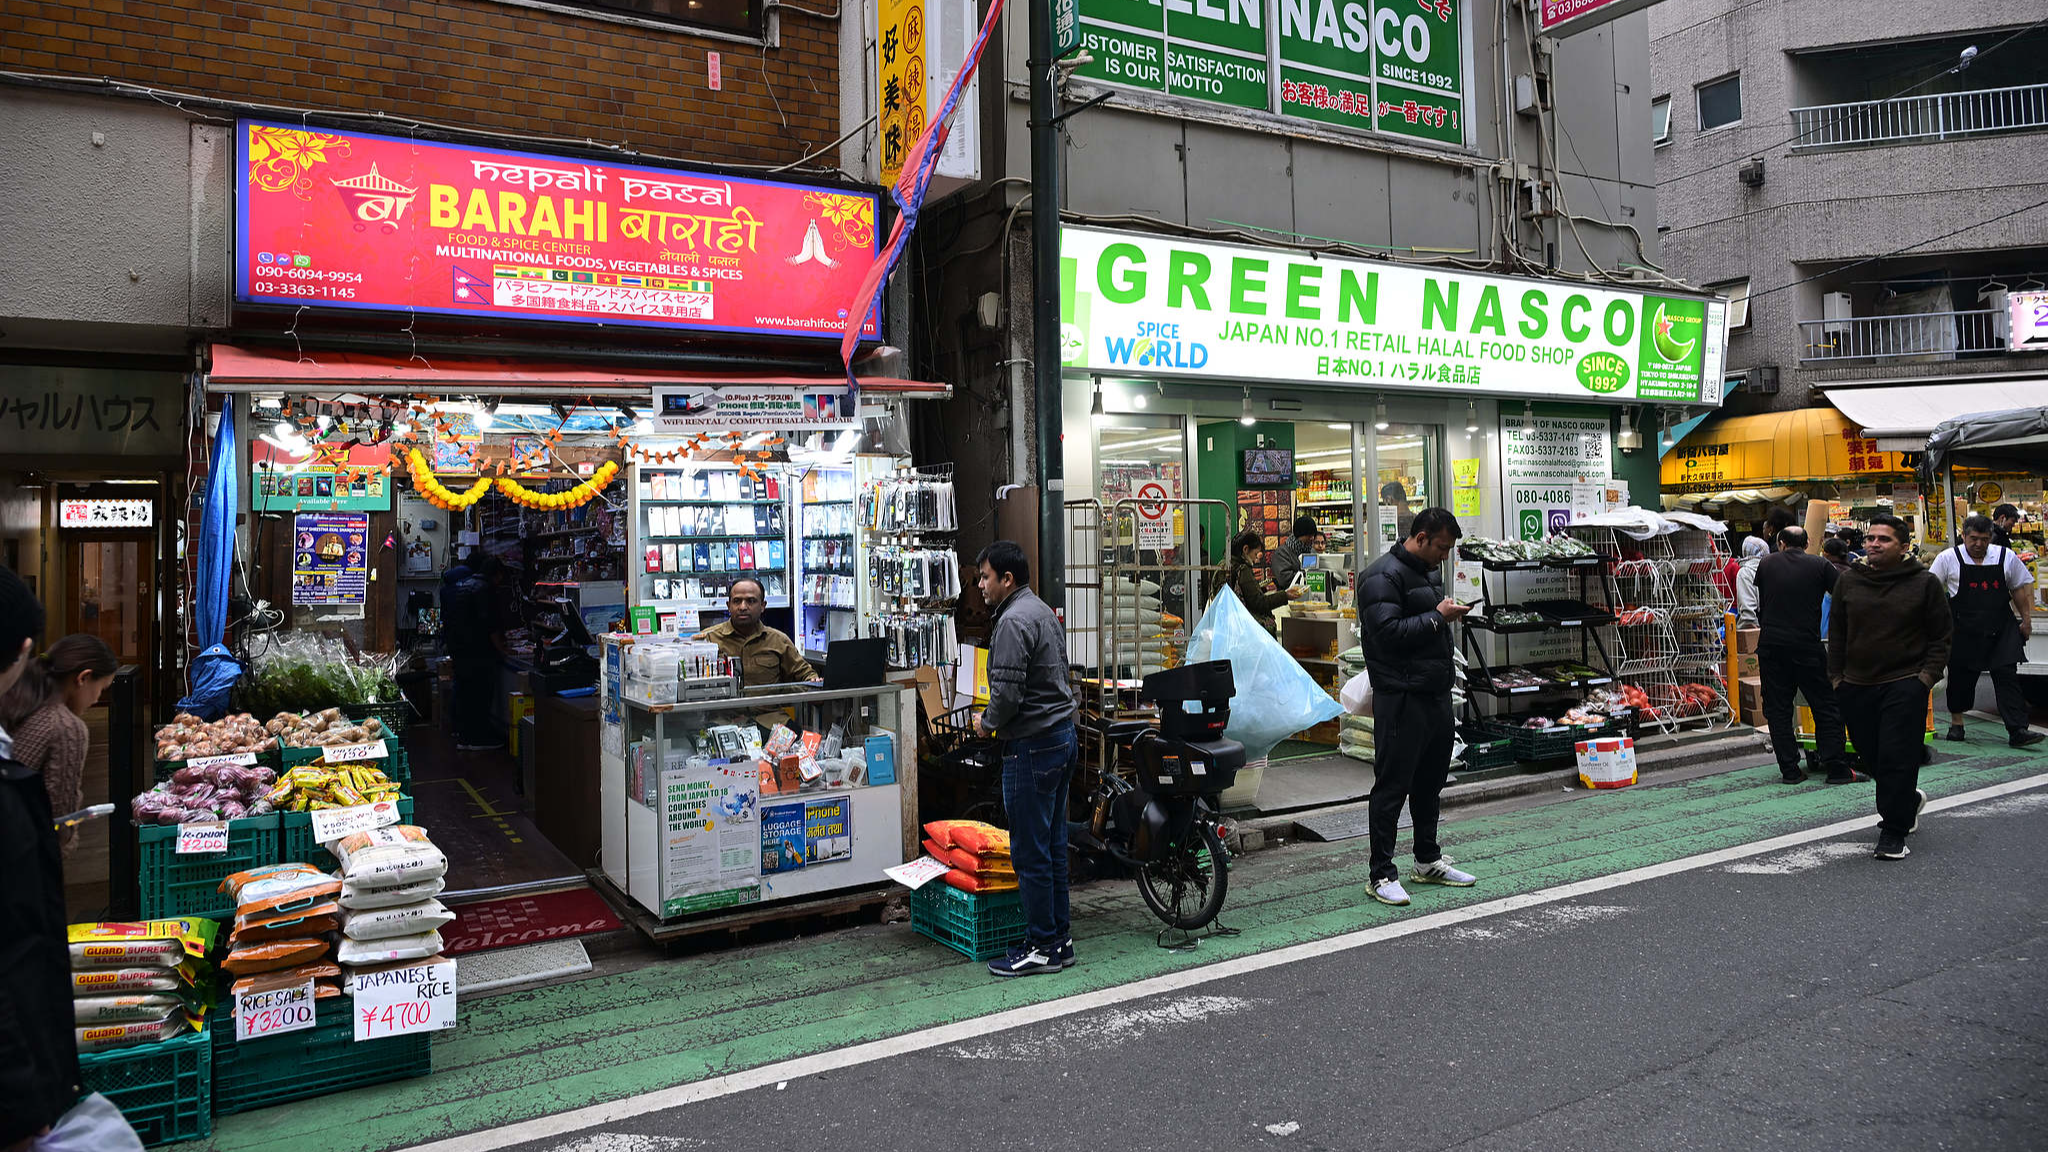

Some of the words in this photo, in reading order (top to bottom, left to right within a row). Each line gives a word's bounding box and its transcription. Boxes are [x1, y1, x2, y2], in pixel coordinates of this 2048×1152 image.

[1281, 0, 1431, 63] NASCO
[1079, 32, 1158, 62] USTOMER
[1167, 51, 1266, 84] SATISFACTION
[906, 17, 920, 143] 麻辣湯
[1105, 57, 1121, 74] IS
[1125, 62, 1161, 83] OUR
[1169, 71, 1223, 95] MOTTO
[882, 24, 901, 165] 好美味
[470, 160, 608, 193] nepali
[619, 175, 733, 207] pasal
[429, 183, 608, 243] BARAHI
[618, 205, 764, 254] बाराही
[448, 233, 488, 247] FOOD
[491, 236, 501, 248] &
[503, 237, 540, 251] SPICE
[542, 241, 592, 255] CENTER
[435, 245, 553, 265] MULTINATIONAL
[555, 254, 606, 271] FOODS,
[609, 259, 689, 276] VEGETABLES
[691, 266, 700, 277] &
[702, 267, 743, 280] SPICES
[255, 265, 363, 283] 090-6094-9954
[254, 281, 356, 299] 03-3363-1145
[1096, 242, 1379, 325] GREEN
[1421, 278, 1635, 346] NASCO
[1136, 321, 1180, 339] SPICE
[1105, 336, 1208, 369] WORLD
[1218, 320, 1289, 345] JAPAN
[1295, 326, 1339, 348] NO.1
[1346, 331, 1411, 354] RETAIL
[1417, 336, 1474, 359] HALAL
[1480, 341, 1526, 361] FOOD
[1531, 346, 1574, 365] SHOP
[1391, 362, 1481, 384] ハラル食品店
[1582, 357, 1624, 377] SINCE
[1588, 375, 1617, 391] 1992
[1506, 430, 1524, 441] TEL
[1539, 420, 1550, 428] OF
[1551, 420, 1578, 429] NASCO
[1579, 421, 1605, 430] GROUP
[667, 783, 686, 793] SEND
[686, 780, 711, 790] MONEY
[667, 793, 688, 803] FROM
[688, 790, 709, 800] JAPAN
[710, 789, 719, 797] TO
[720, 788, 728, 796] 18
[668, 800, 707, 813] COUNTRIES
[668, 811, 697, 822] AROUND
[668, 822, 682, 832] THE
[682, 819, 707, 830] WORLD
[762, 819, 802, 831] LUGGAGE
[762, 827, 802, 839] STORAGE
[762, 838, 781, 846] HERE
[356, 965, 437, 991] JAPANESE
[240, 994, 271, 1012] RICE
[275, 987, 309, 1006] SALE
[417, 981, 453, 999] RICE
[361, 1000, 431, 1037] ¥4700
